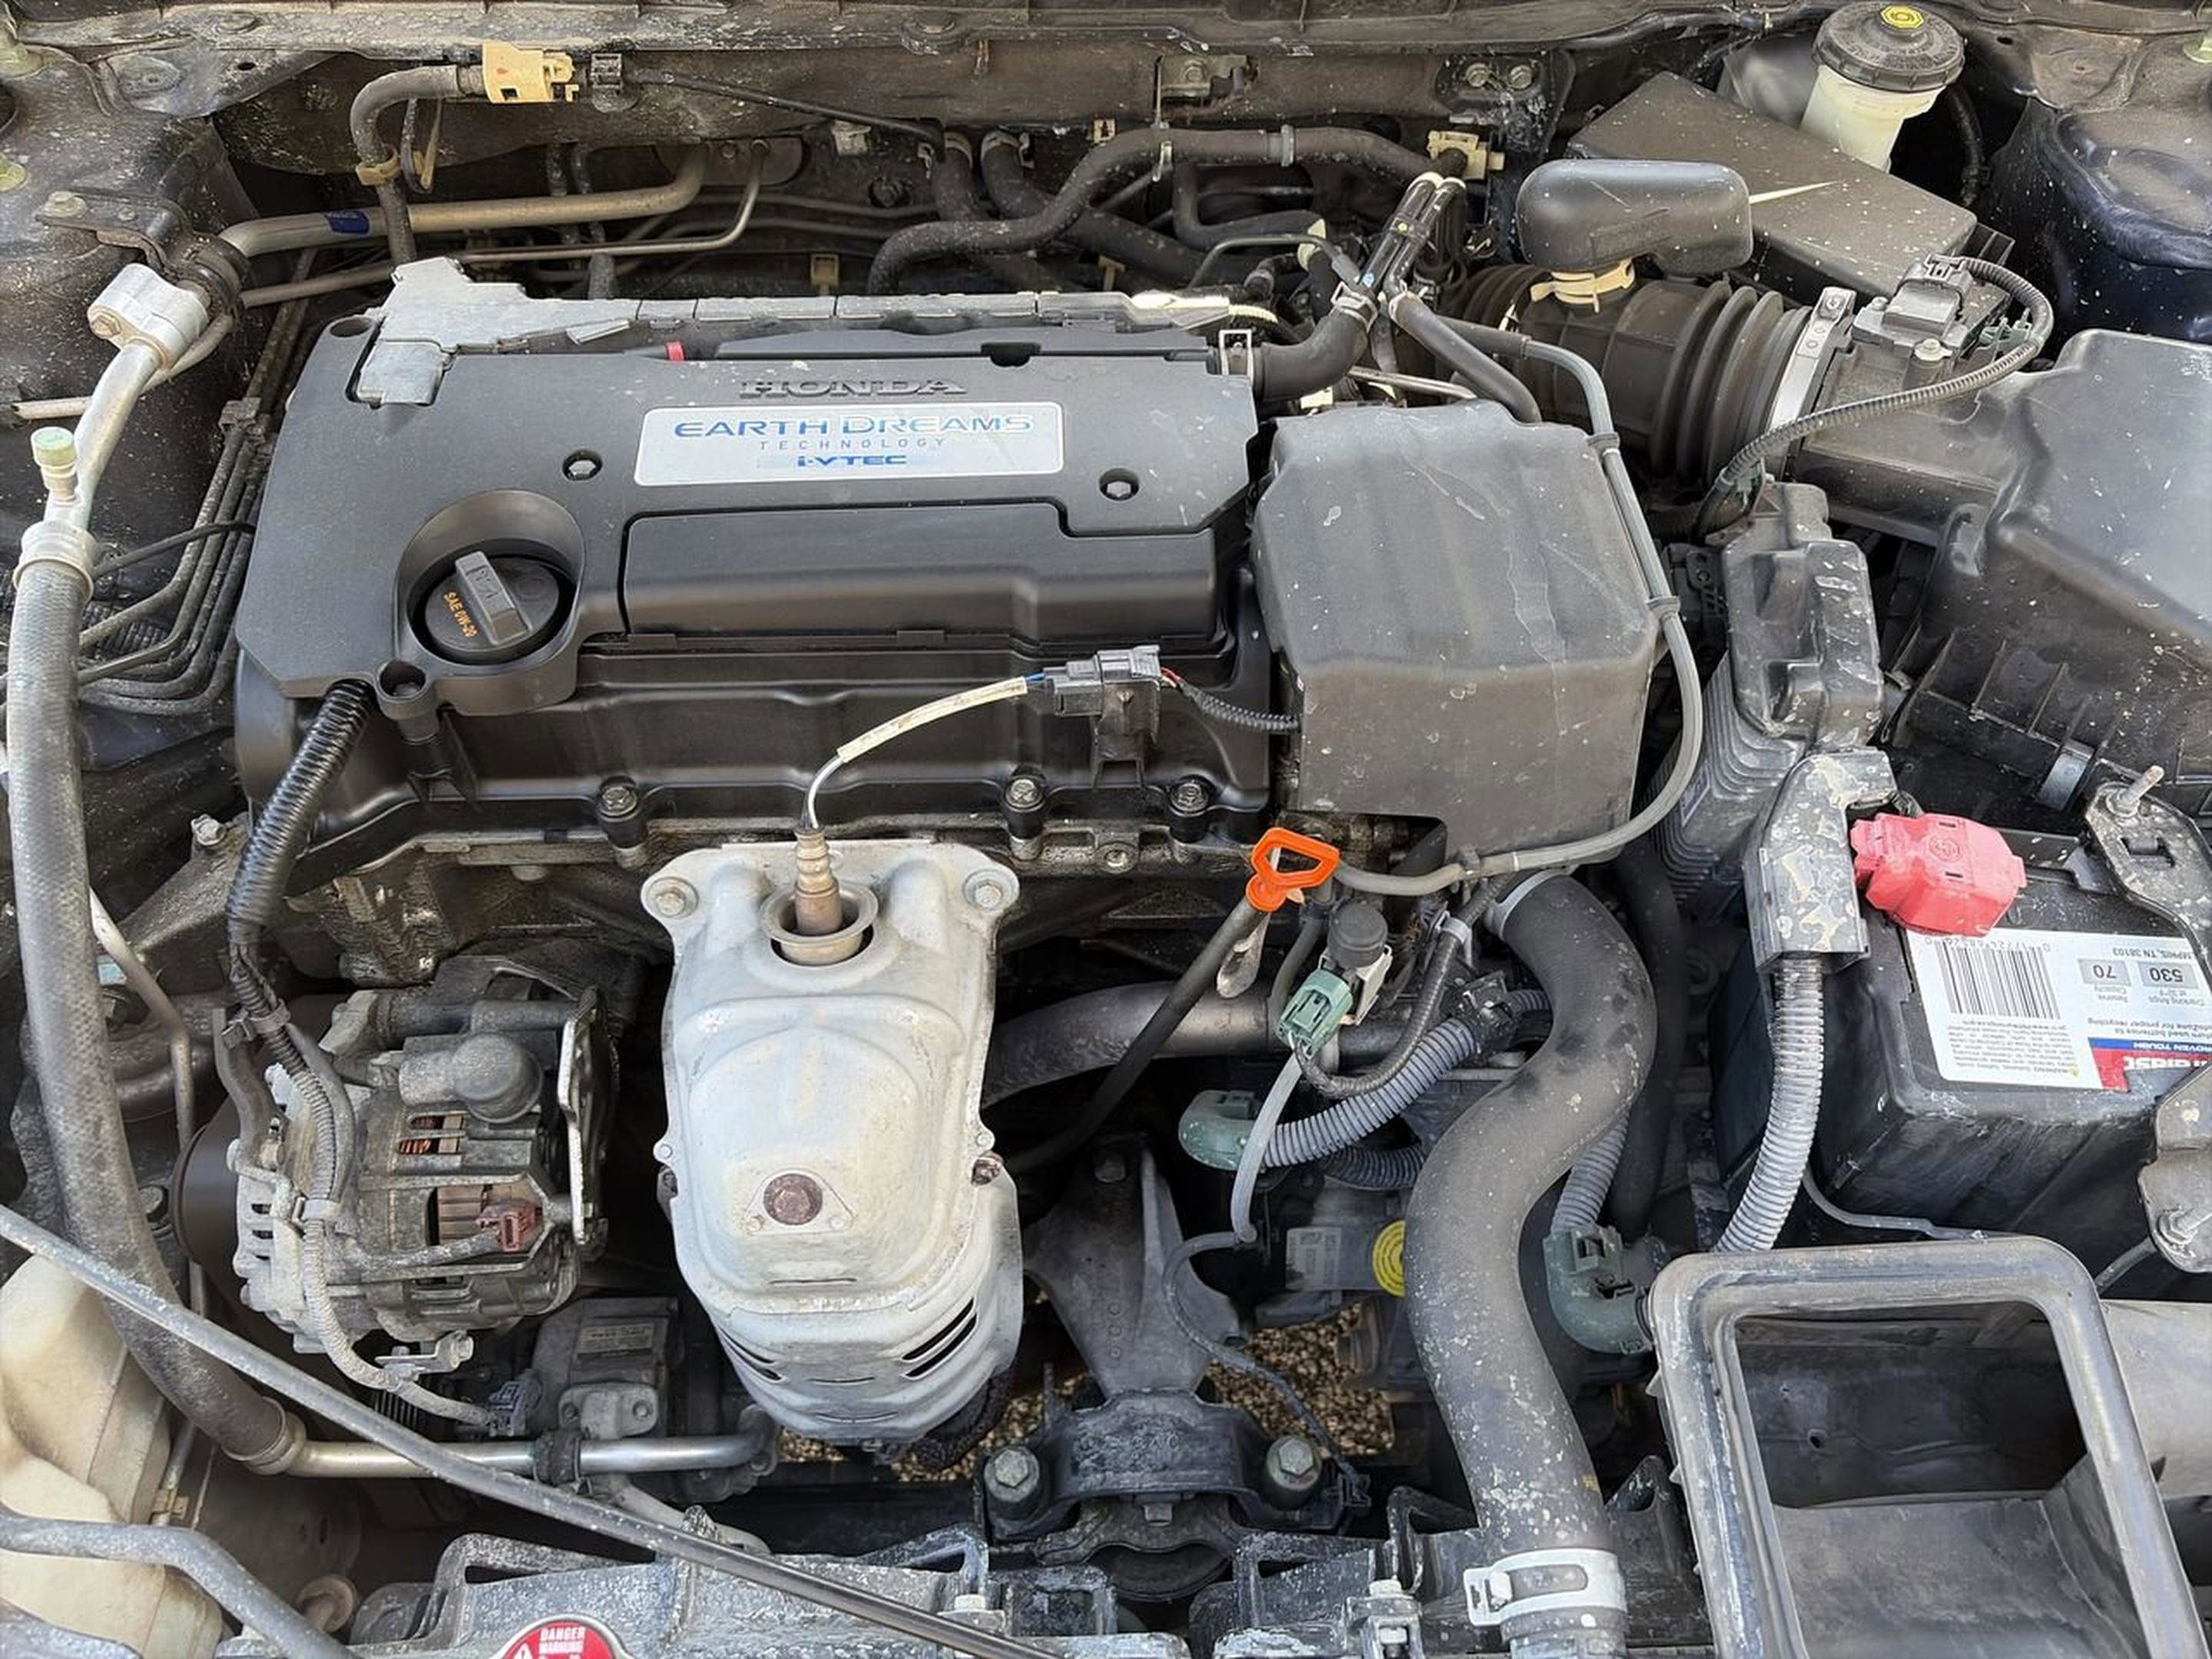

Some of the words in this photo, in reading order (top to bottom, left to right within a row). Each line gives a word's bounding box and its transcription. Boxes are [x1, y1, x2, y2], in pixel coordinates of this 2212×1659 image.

[740, 379, 967, 399] HONDA
[674, 419, 828, 438] EARTH
[842, 414, 1031, 434] DREAMS
[760, 438, 945, 451] TECHNOLOGY
[797, 455, 907, 467] i-VTEC
[443, 591, 463, 612] SAE
[2143, 949, 2157, 959] TN
[2092, 964, 2116, 979] 70
[2149, 967, 2184, 983] 530
[2173, 1044, 2212, 1054] ROVEN
[541, 1627, 586, 1641] DANGER
